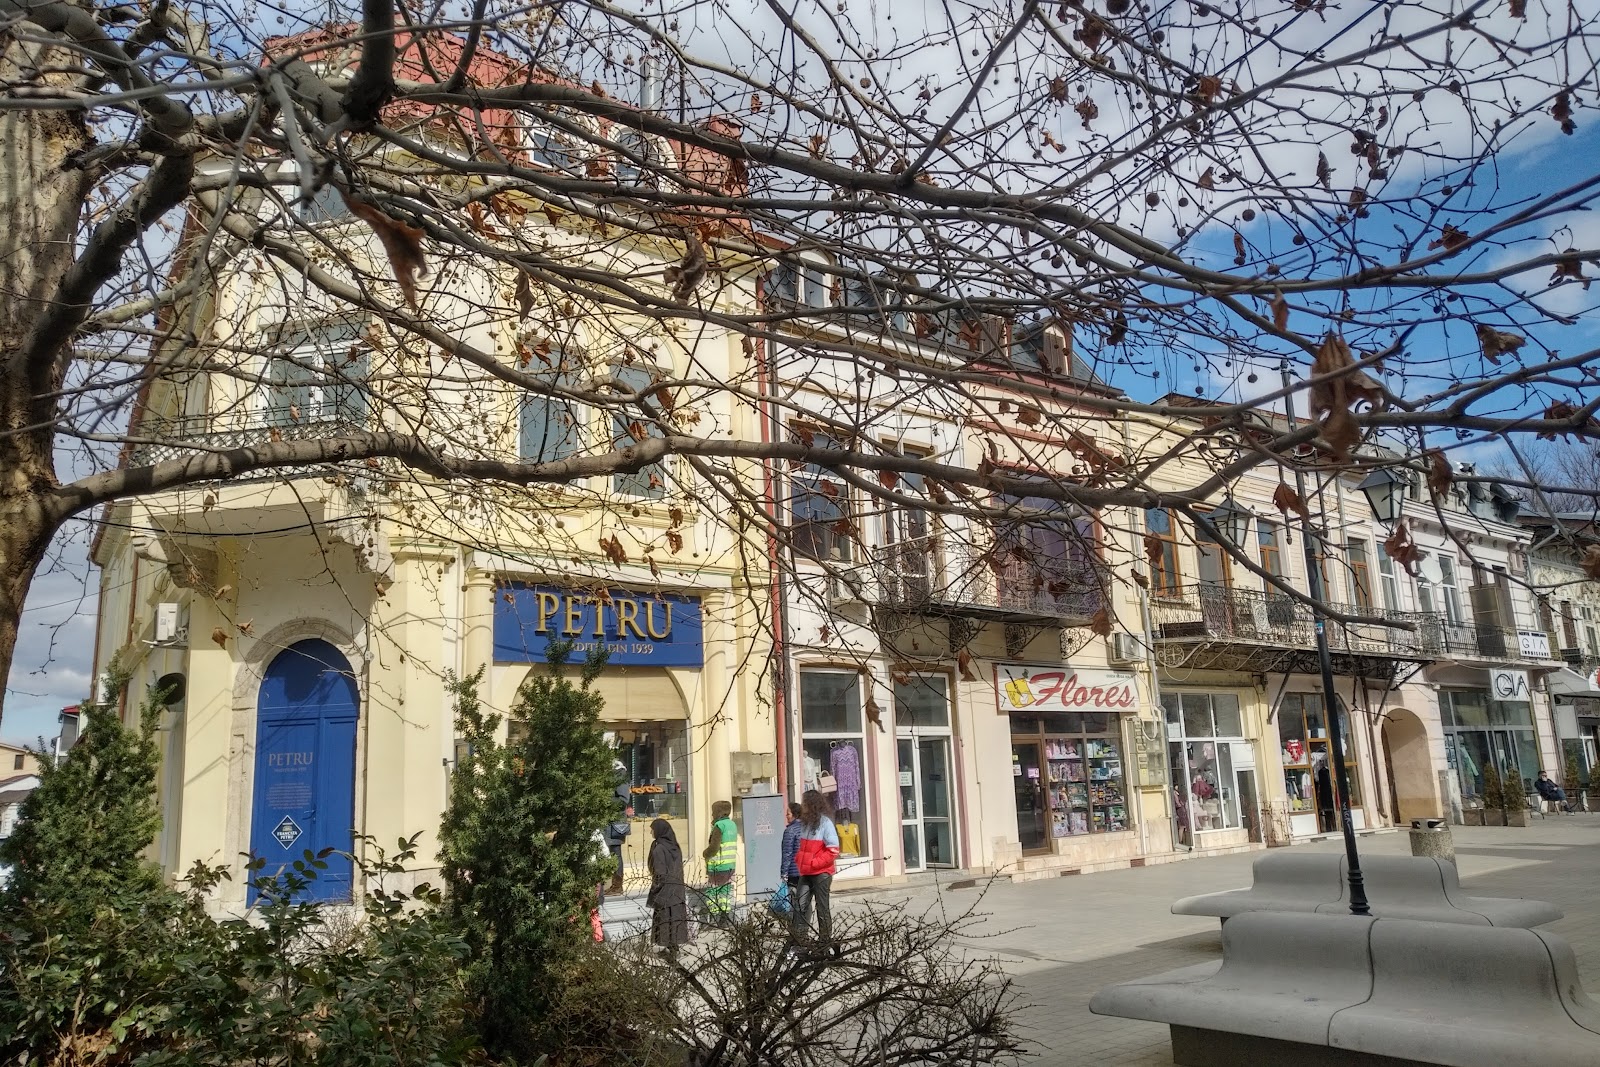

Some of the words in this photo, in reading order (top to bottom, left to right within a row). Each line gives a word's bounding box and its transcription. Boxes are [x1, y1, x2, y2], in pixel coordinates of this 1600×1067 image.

[535, 592, 673, 639] PETRU
[607, 643, 628, 654] DIN
[631, 643, 654, 655] 1939
[1522, 638, 1547, 650] GIA
[1029, 672, 1135, 708] Flores
[1494, 673, 1531, 698] GIA
[268, 752, 313, 766] PETRU
